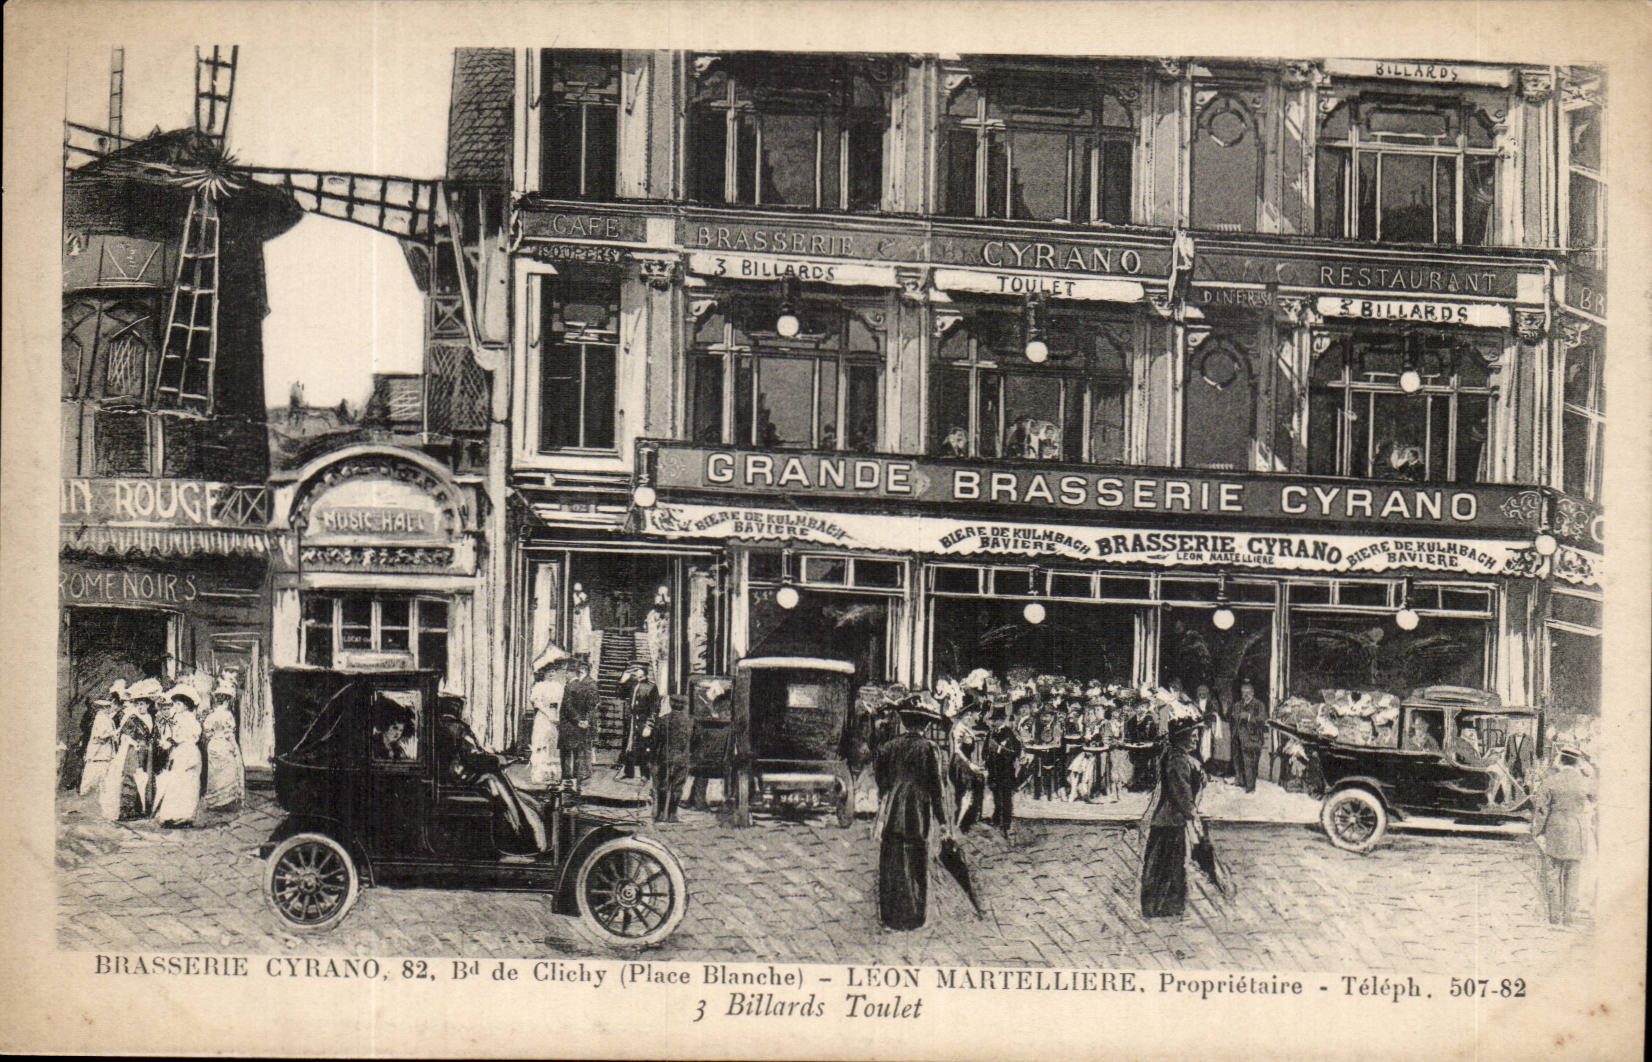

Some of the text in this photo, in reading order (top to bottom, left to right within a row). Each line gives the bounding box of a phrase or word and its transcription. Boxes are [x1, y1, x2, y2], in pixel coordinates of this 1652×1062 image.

[1376, 63, 1458, 81] BILLARDS
[553, 214, 619, 238] CAFE
[697, 226, 855, 256] BRASSERIE
[714, 258, 835, 281] 3 BILLARDS
[982, 241, 1142, 274] CYRANO
[997, 275, 1076, 298] TOULET
[1320, 266, 1497, 291] RESTAURANT
[1361, 301, 1469, 322] BILLARDS
[707, 452, 1477, 521] GRANDE BRASSERIE CYRANO
[115, 479, 222, 527] ROUGE
[323, 511, 425, 532] MUSIC HALL
[695, 510, 848, 540] BIERE DE KULMBACH
[734, 521, 810, 537] BAVIERE
[939, 526, 1091, 555] BIERE DE KULMBACH
[978, 536, 1058, 552] BAVIERE
[1095, 533, 1342, 565] BRASSERIE CYRANO
[1347, 540, 1497, 570] BIERE DE KULMBACH
[1388, 551, 1459, 568] BAVIERE
